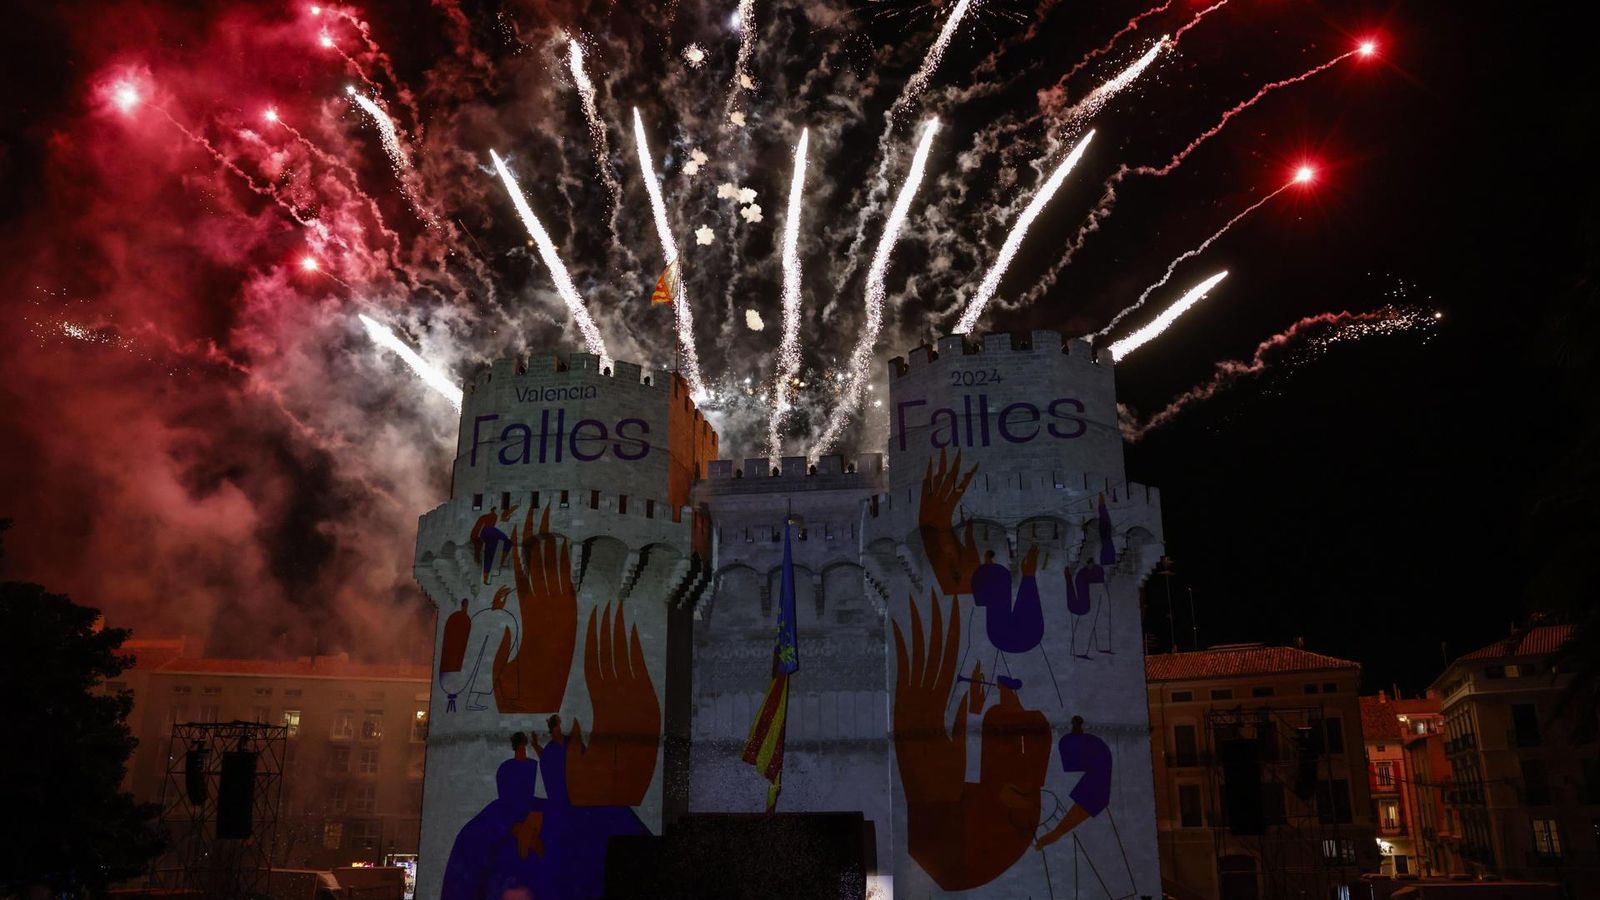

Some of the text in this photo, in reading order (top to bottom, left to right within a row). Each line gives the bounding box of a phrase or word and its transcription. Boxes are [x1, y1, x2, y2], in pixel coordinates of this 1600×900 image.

[515, 384, 597, 403] Valencia
[951, 369, 1003, 387] 2024
[470, 408, 651, 467] Falles
[897, 394, 1088, 452] Falles
